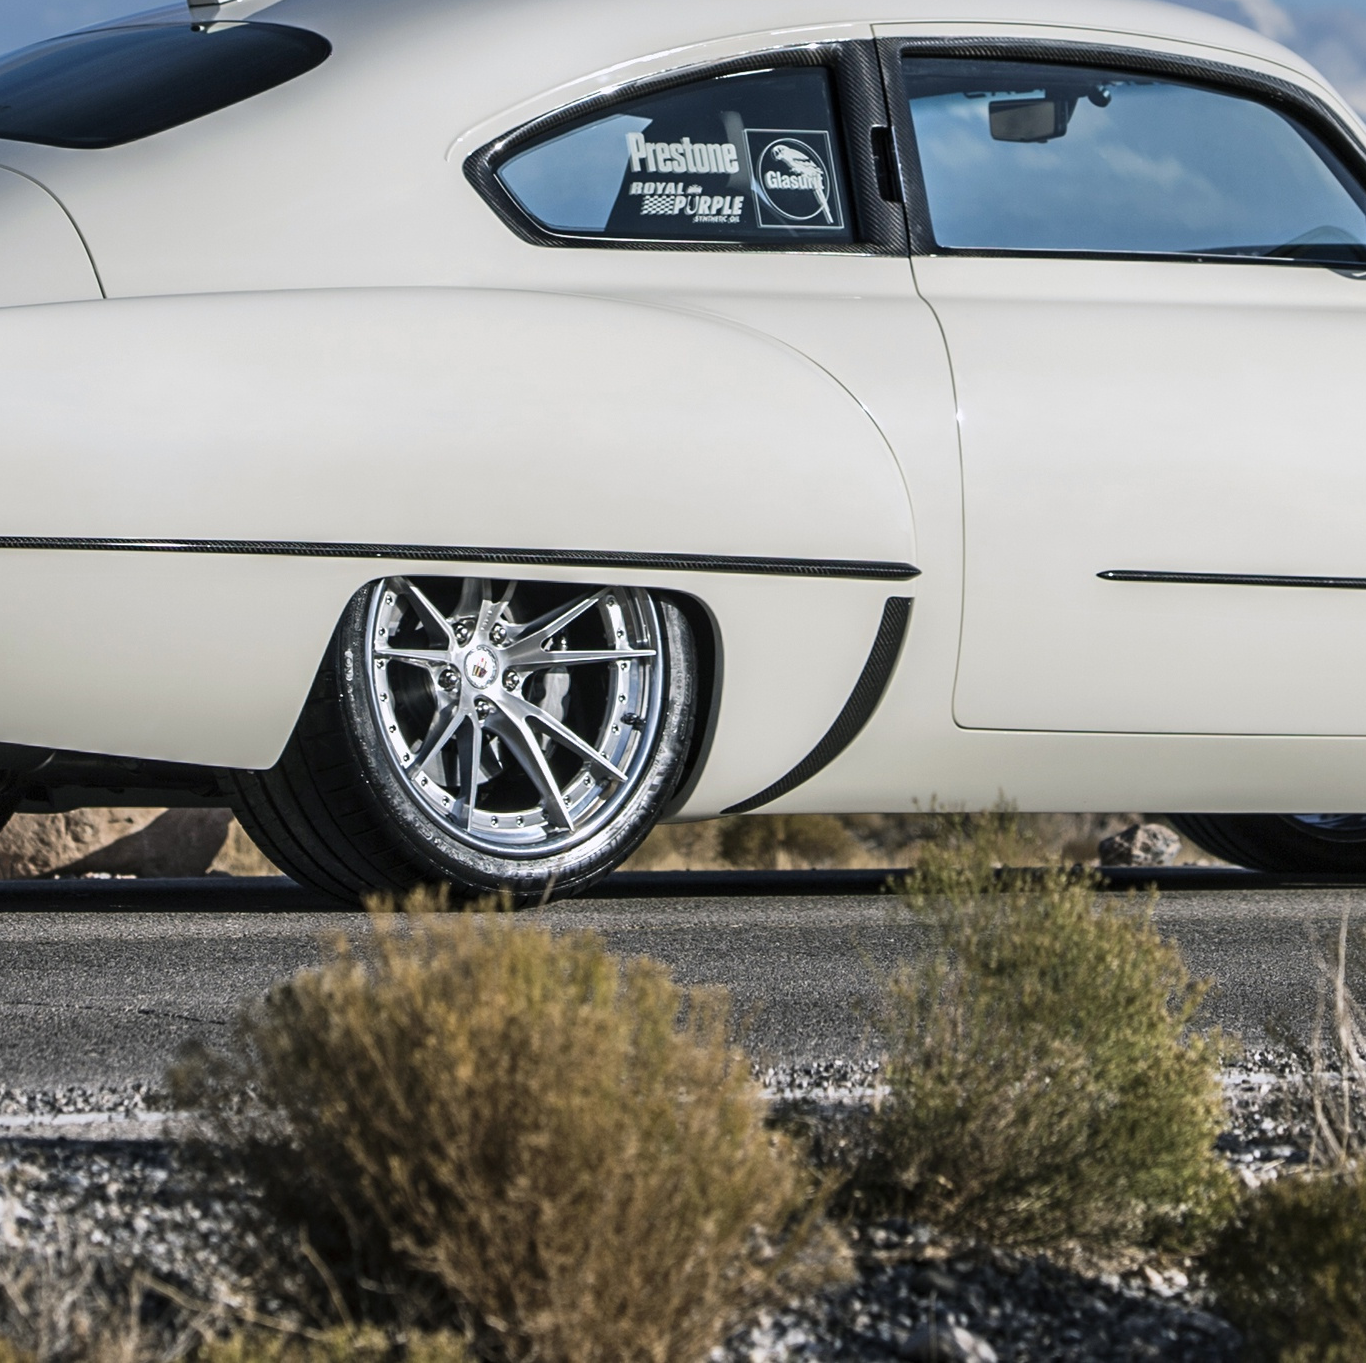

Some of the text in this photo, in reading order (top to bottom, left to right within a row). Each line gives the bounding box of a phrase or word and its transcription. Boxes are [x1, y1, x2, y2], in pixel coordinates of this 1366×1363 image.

[626, 132, 739, 174] Prestone
[629, 182, 685, 195] ROYAL
[764, 170, 825, 189] Glasur
[673, 196, 745, 215] PURPLE
